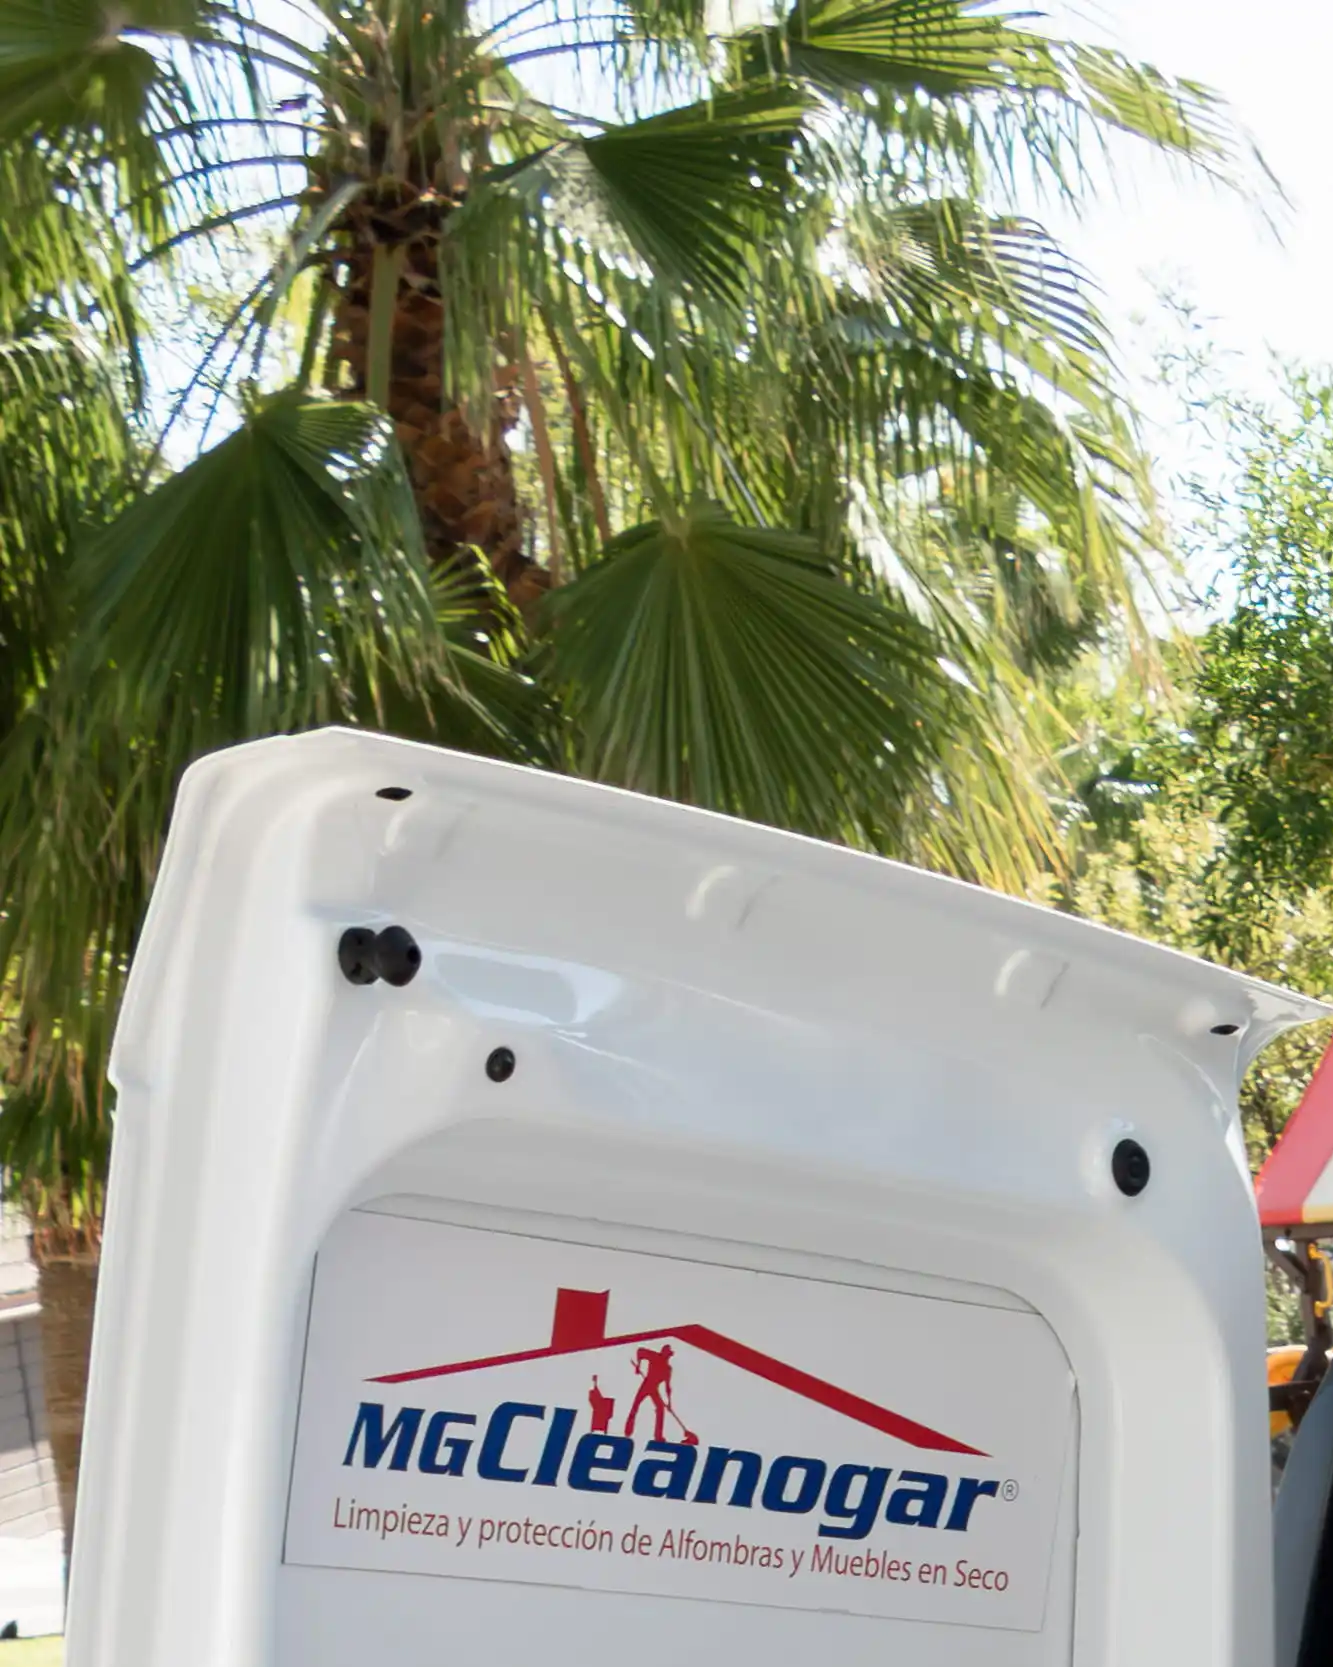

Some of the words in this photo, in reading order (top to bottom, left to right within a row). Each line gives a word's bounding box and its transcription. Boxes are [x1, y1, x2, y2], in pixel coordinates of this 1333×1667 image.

[332, 1497, 449, 1540] Limpieza
[455, 1517, 472, 1547] y
[477, 1516, 613, 1552] protección
[620, 1524, 652, 1556] de
[659, 1529, 784, 1569] Alfombras
[789, 1549, 805, 1578] y
[810, 1544, 912, 1583] Muebles
[917, 1563, 948, 1585] en
[953, 1559, 1010, 1592] Seco
